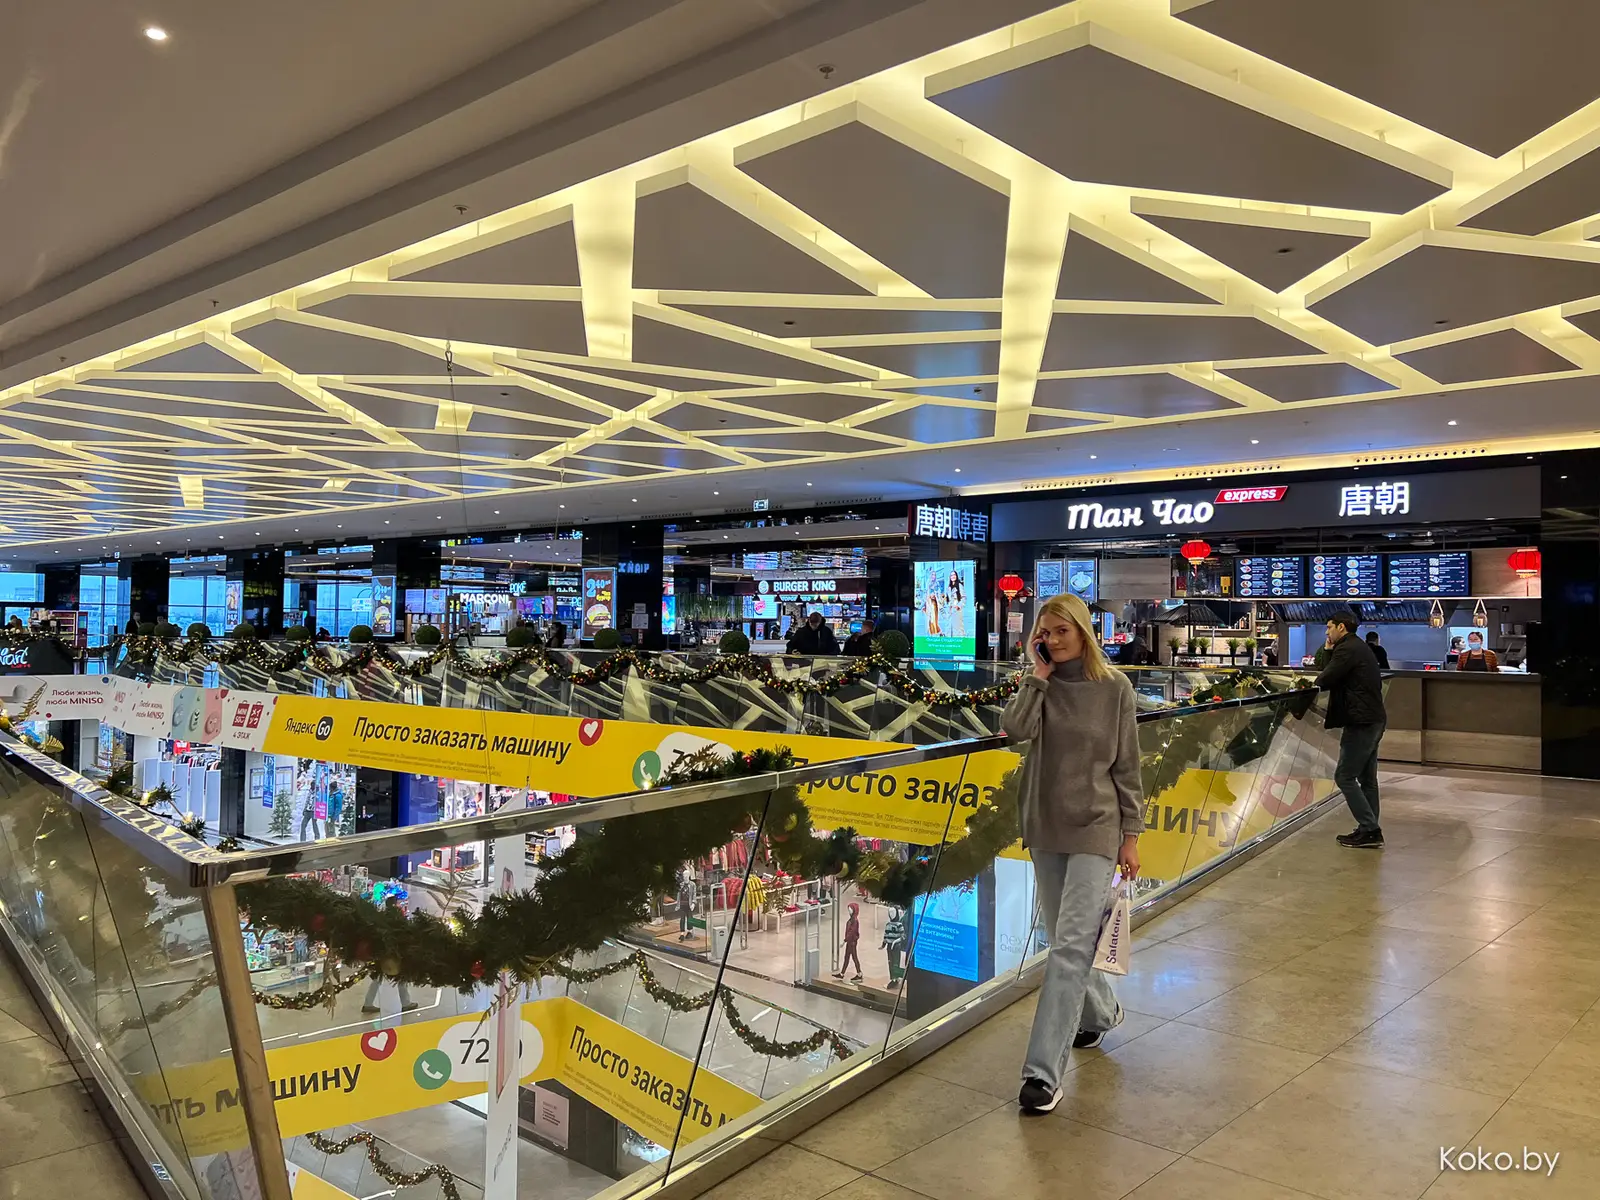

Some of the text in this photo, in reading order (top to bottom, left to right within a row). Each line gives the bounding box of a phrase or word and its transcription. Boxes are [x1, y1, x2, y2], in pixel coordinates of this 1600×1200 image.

[1224, 488, 1277, 502] express
[1339, 482, 1410, 517] 唐朝
[915, 503, 952, 539] 唐朝
[1068, 499, 1215, 530] Тан Чао
[773, 580, 837, 592] BURGER KING
[52, 689, 75, 697] Люби
[69, 697, 104, 705] MINISO
[237, 731, 251, 740] ЭТАЖ
[285, 717, 331, 737] Яндекс Go
[353, 716, 410, 743] Просто
[412, 726, 488, 751] заказать
[491, 734, 572, 765] машину
[1105, 909, 1122, 964] Salateira
[569, 1025, 629, 1079] Просто
[215, 1064, 362, 1113] мшину
